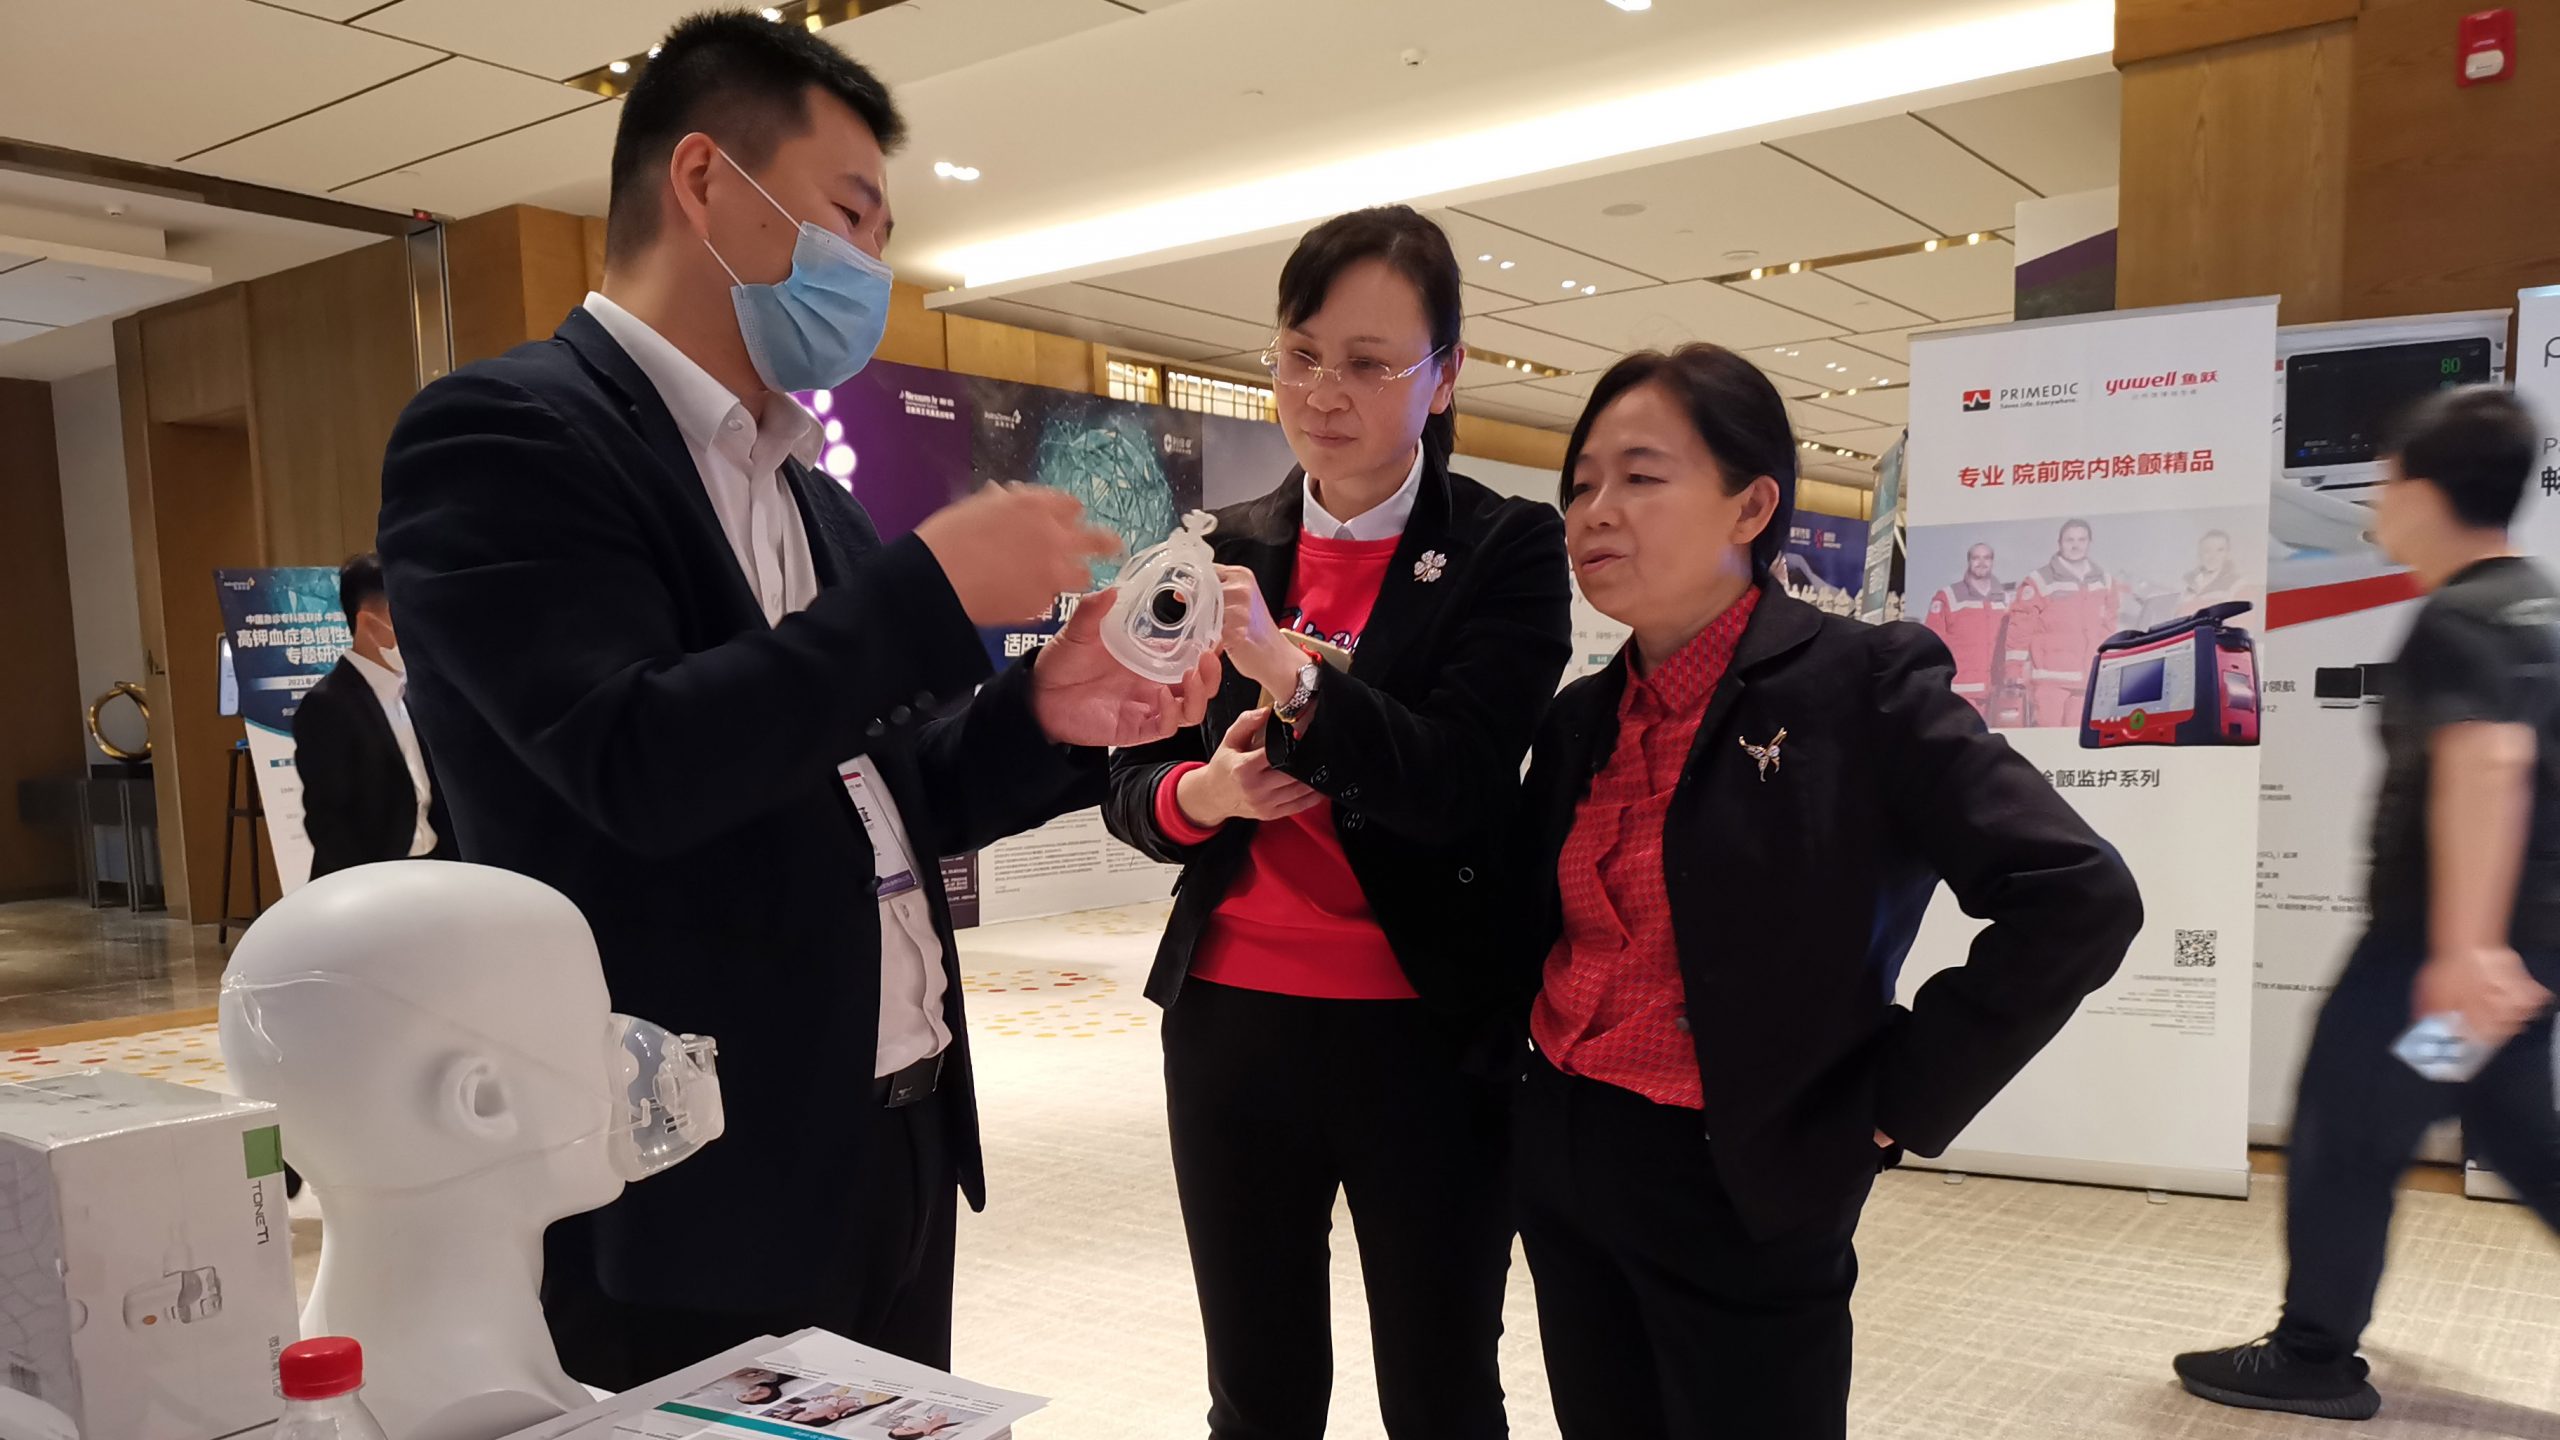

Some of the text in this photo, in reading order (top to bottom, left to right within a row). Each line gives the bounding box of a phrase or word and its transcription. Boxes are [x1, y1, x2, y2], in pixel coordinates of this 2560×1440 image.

[2441, 357, 2461, 374] 80
[2105, 371, 2178, 396] yuwell
[2181, 370, 2219, 386] 鱼跃
[2000, 382, 2079, 401] PRIMEDIC
[1959, 449, 2215, 489] 专业 院前院内除颤精品
